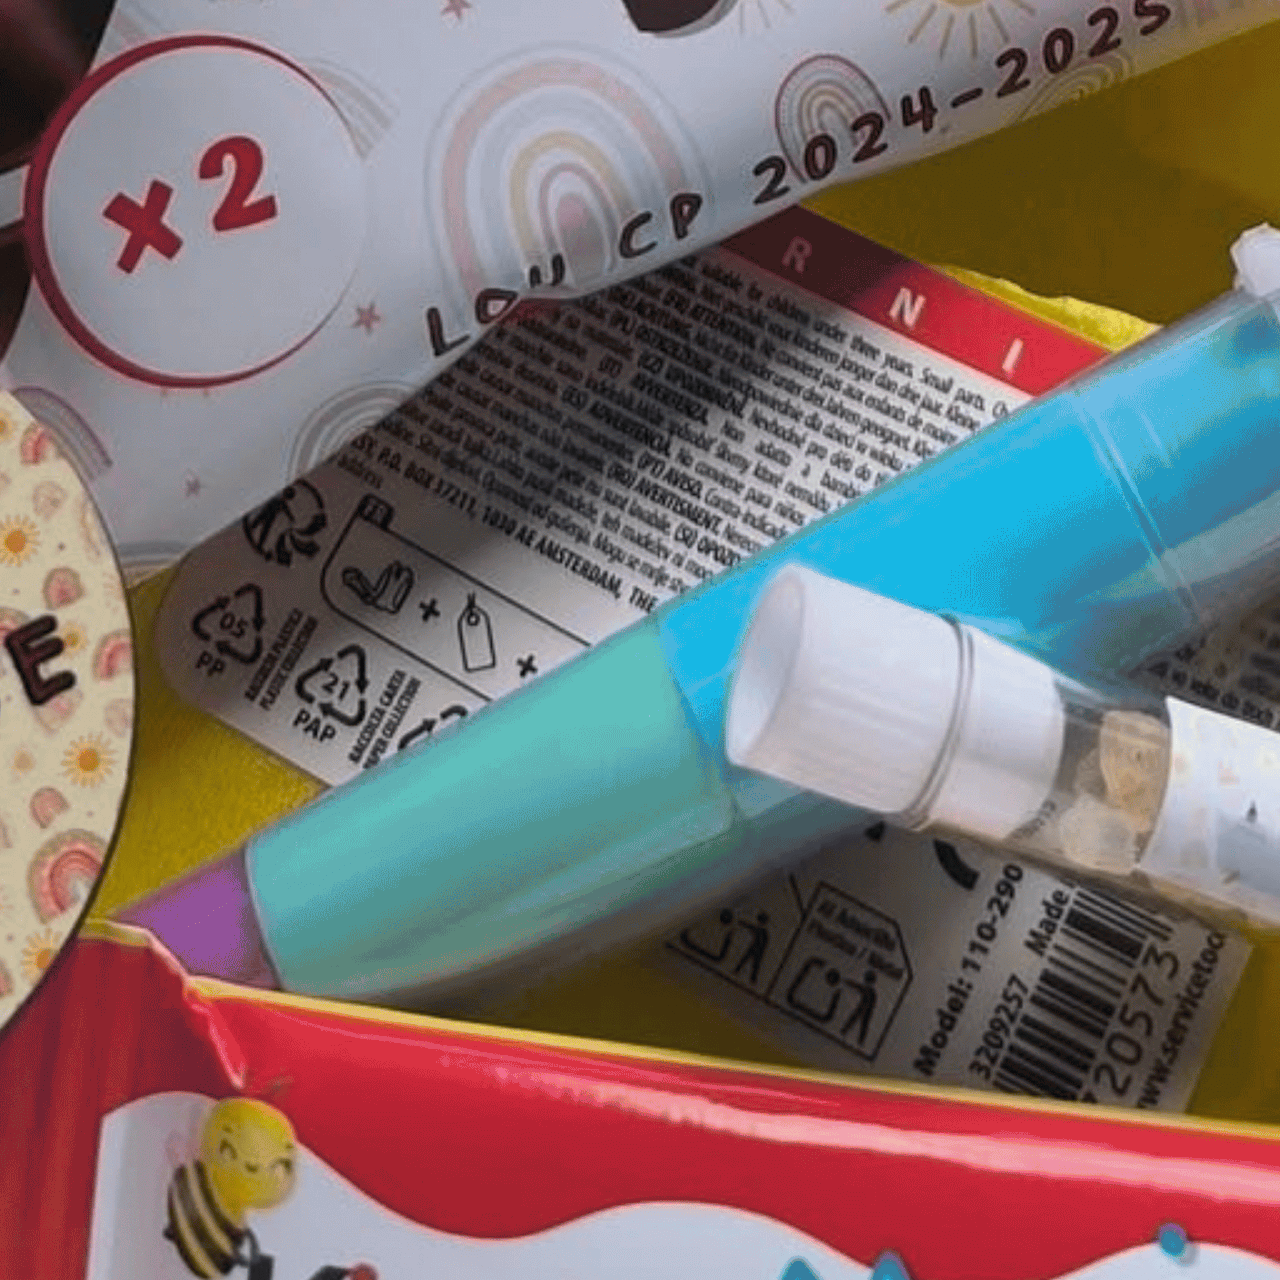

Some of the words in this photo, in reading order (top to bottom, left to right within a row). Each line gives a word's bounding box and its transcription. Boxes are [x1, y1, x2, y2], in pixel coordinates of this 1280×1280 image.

[619, 191, 703, 260] CP
[811, 313, 850, 346] under
[848, 332, 883, 362] three
[917, 364, 955, 396] Small
[952, 385, 990, 416] parts.
[873, 371, 900, 395] dan
[818, 372, 843, 395] pas
[840, 382, 866, 404] aux
[861, 389, 910, 425] enfants
[905, 411, 925, 430] de
[718, 420, 748, 445] Non
[802, 409, 825, 431] dla
[803, 440, 829, 464] pro
[743, 485, 774, 512] para
[401, 460, 437, 490] BOX
[513, 523, 538, 548] AE
[530, 534, 629, 600] AMSTERDAM,
[625, 586, 660, 615] THE
[220, 612, 249, 639] 05
[195, 650, 226, 678] PP
[321, 672, 350, 702] 21
[292, 708, 337, 743] PAP
[913, 976, 976, 1077] Model:
[963, 864, 1024, 977] 110-290
[970, 973, 1031, 1081] 3209257
[1025, 888, 1068, 959] Made
